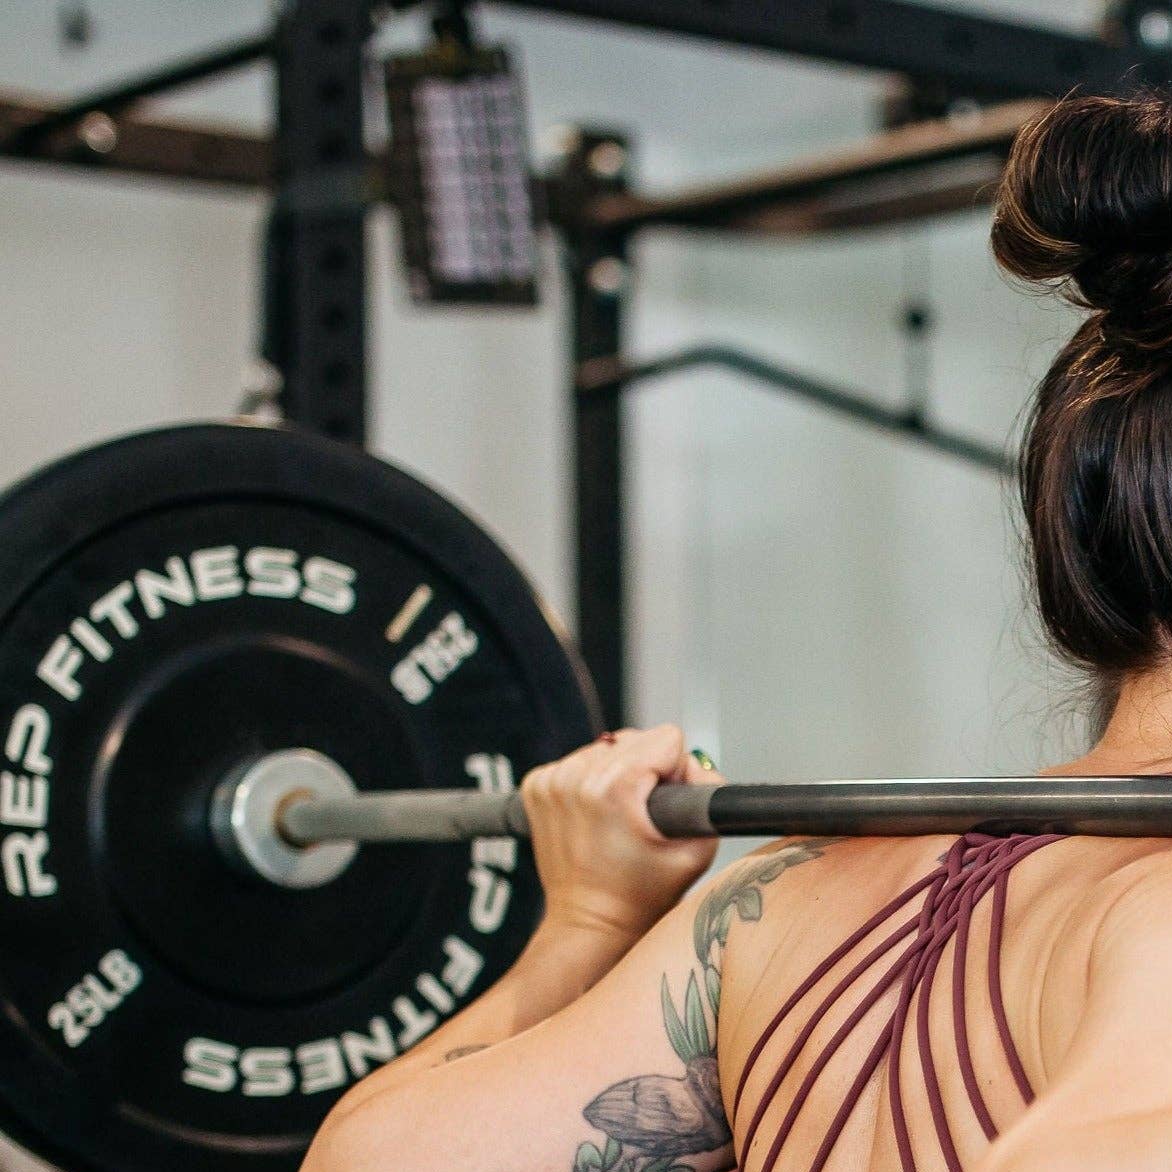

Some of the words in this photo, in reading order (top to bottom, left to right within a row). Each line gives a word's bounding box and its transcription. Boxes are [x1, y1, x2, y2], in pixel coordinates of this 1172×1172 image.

[0, 702, 58, 898] REP
[36, 545, 358, 703] FITNESS
[47, 949, 143, 1049] 25LB
[182, 934, 485, 1098] FITNESS
